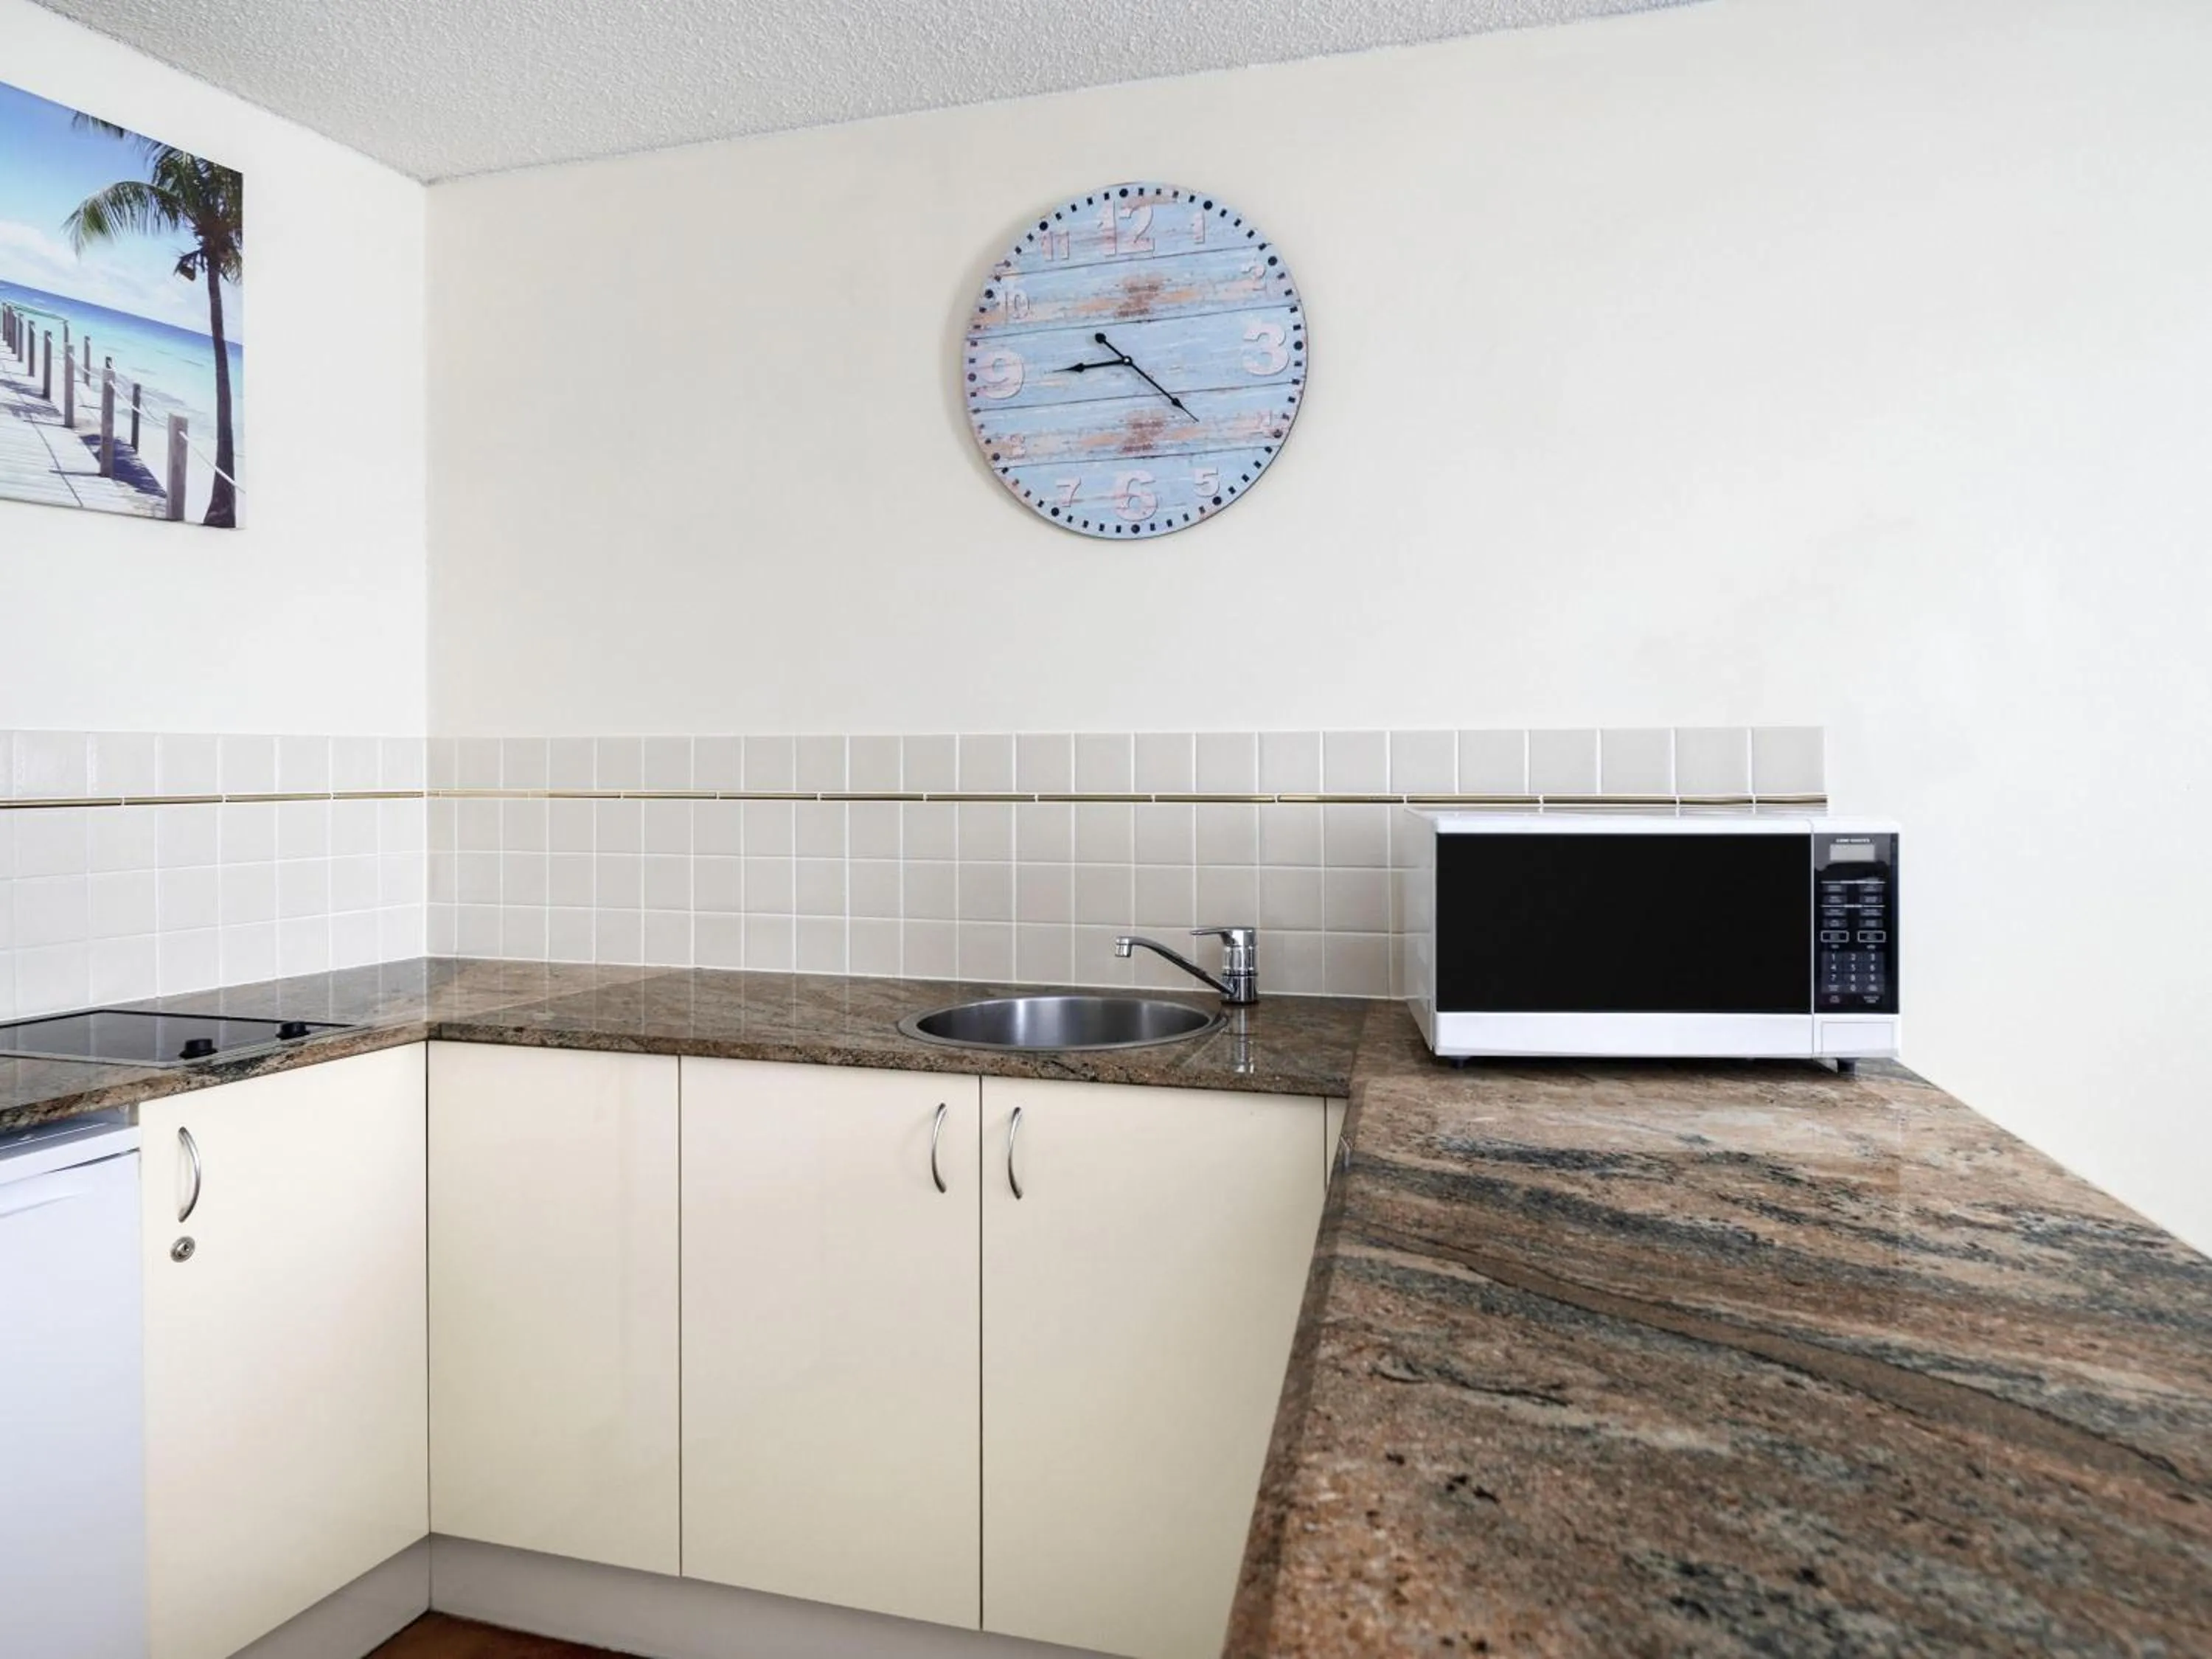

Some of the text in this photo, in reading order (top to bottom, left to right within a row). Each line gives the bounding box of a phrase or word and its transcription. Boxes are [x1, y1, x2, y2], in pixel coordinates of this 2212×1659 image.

[1096, 200, 1155, 257] 12
[1191, 212, 1205, 244] 1
[1040, 231, 1069, 262] 11
[1241, 263, 1267, 291] 2
[995, 290, 1031, 322] 10
[1242, 323, 1289, 376] 3
[978, 350, 1025, 400] 9
[1055, 479, 1081, 507] 7
[1112, 470, 1158, 522] 6
[1193, 468, 1220, 497] 5
